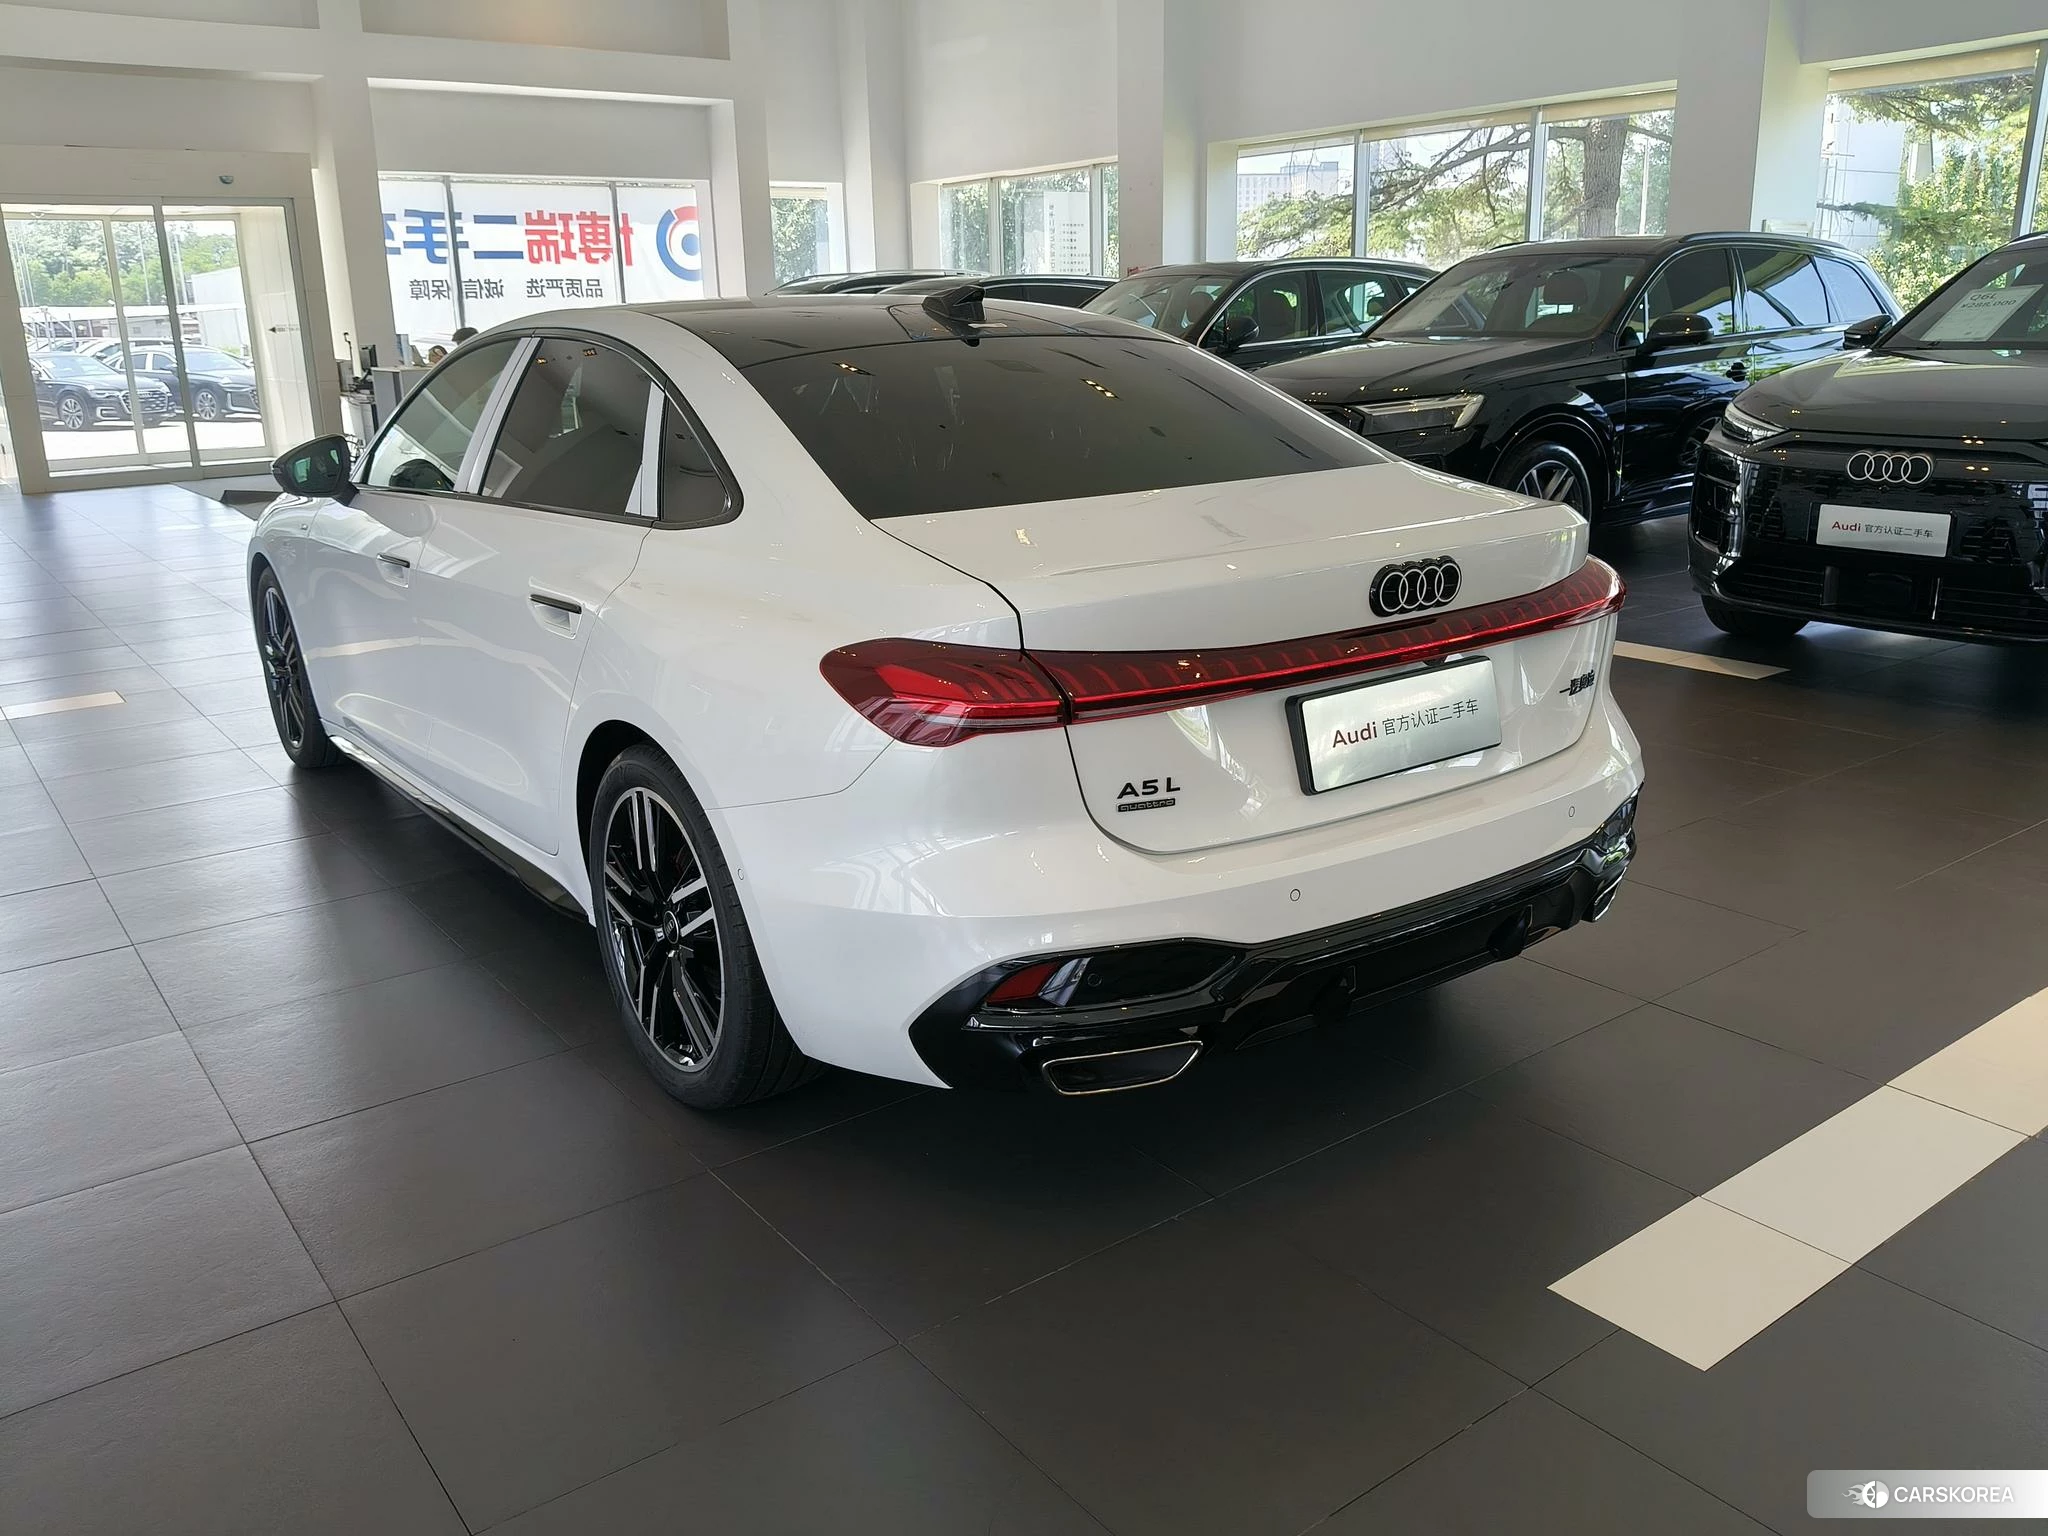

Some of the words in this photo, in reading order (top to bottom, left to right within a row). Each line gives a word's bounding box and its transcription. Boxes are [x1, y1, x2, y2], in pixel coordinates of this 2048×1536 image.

[1831, 521, 1861, 532] Audi
[1865, 523, 1933, 538] 官方认证二手车
[1332, 721, 1378, 748] Audi
[1381, 698, 1479, 736] 官方认证二手车
[1118, 798, 1176, 812] quattro
